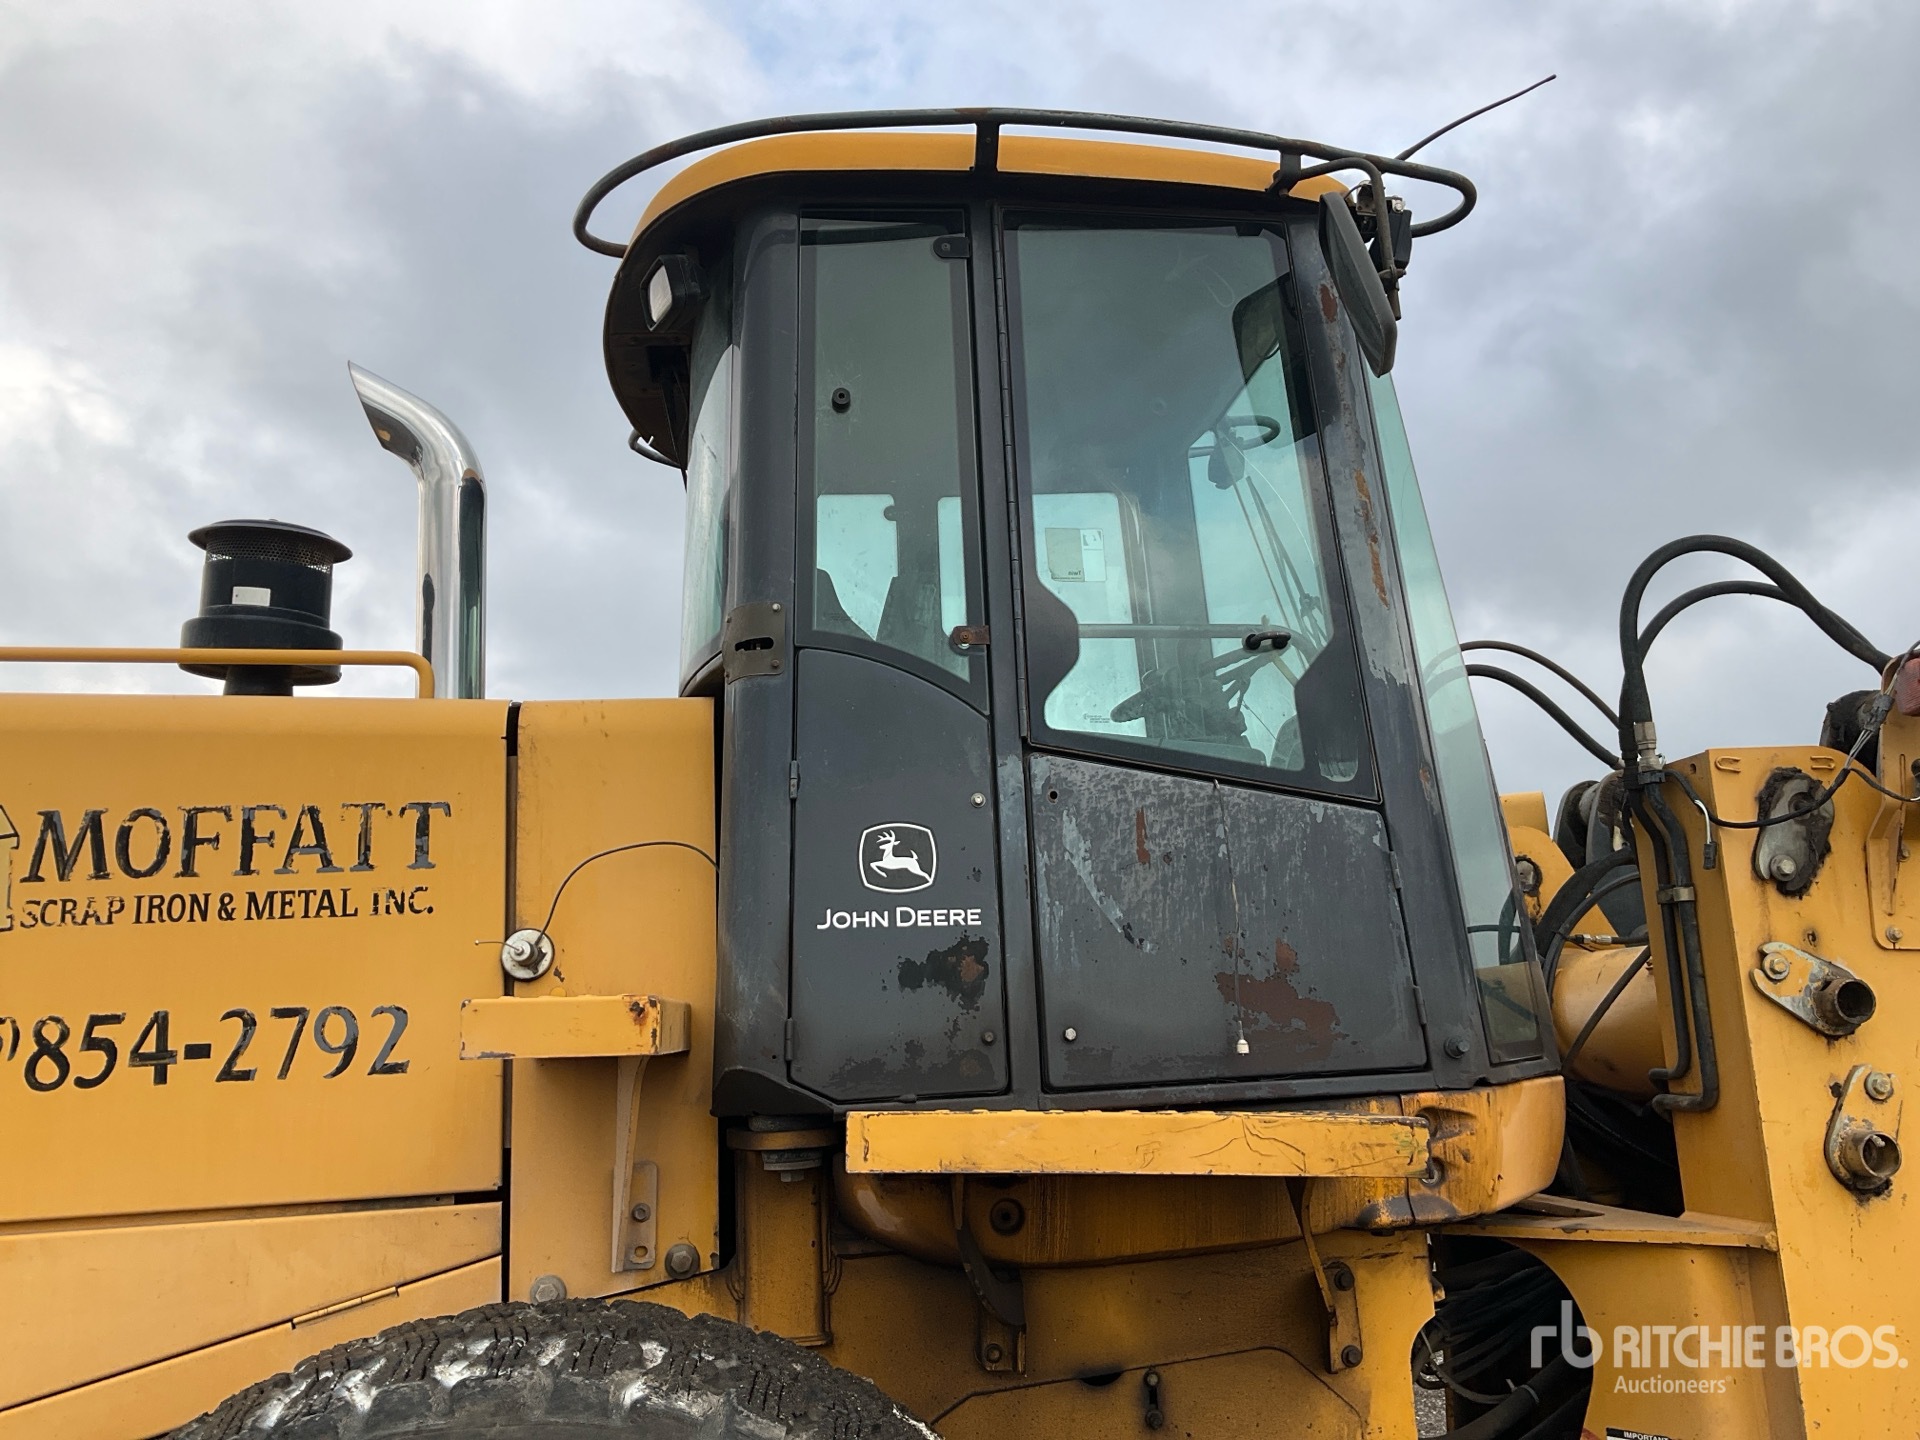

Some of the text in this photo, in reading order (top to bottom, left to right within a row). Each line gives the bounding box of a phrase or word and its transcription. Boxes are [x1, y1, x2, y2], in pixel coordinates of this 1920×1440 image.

[20, 801, 451, 883] MOFFATT
[20, 886, 434, 928] SCRAP IRON & METAL INC.
[816, 906, 982, 929] JOHN DEERE
